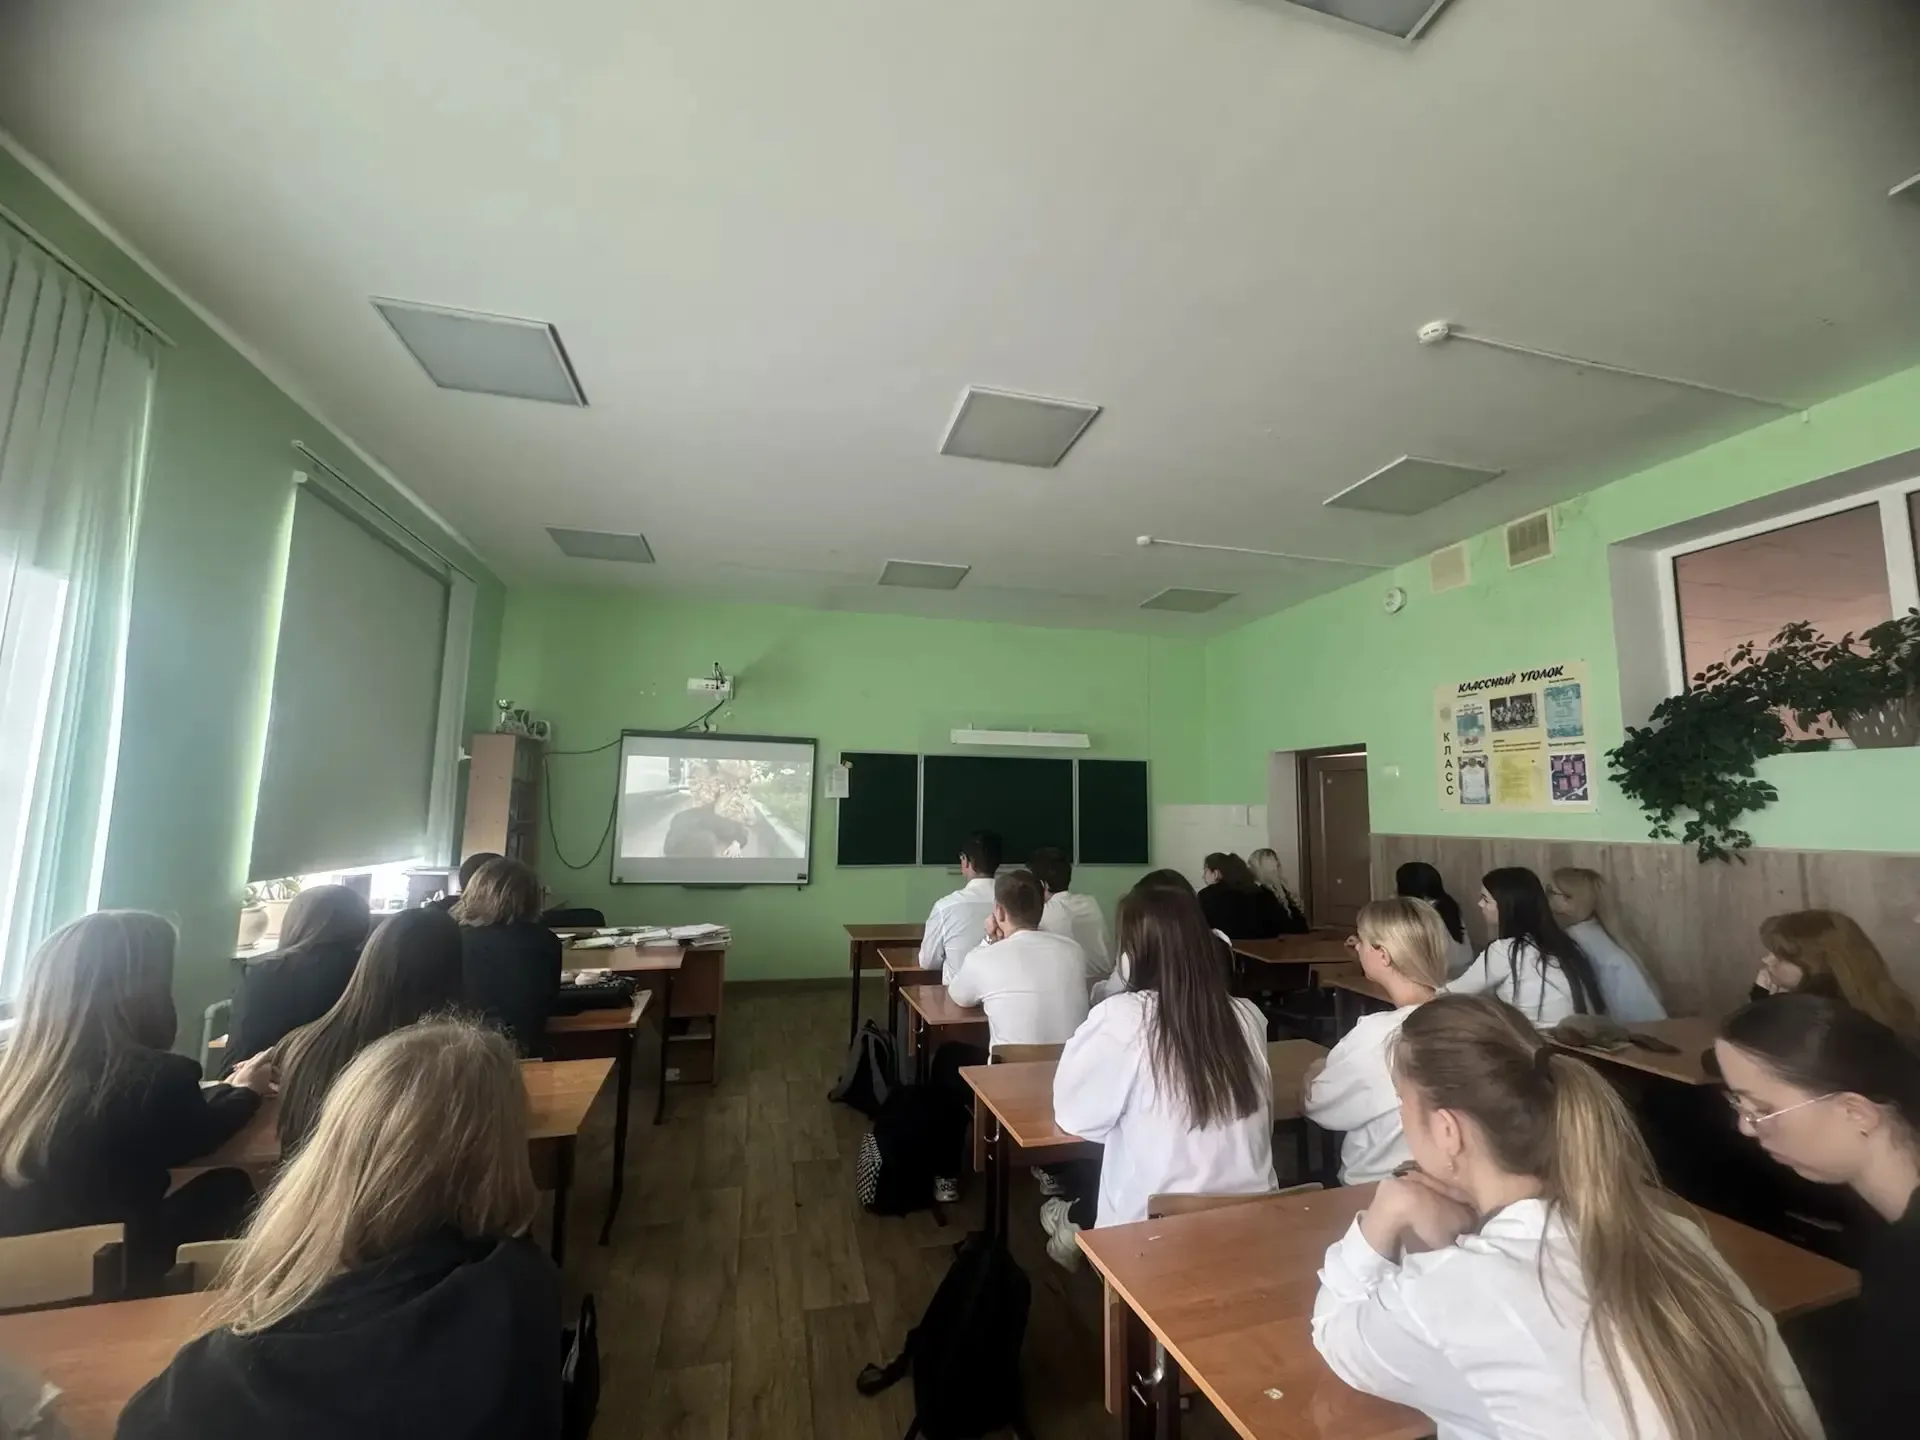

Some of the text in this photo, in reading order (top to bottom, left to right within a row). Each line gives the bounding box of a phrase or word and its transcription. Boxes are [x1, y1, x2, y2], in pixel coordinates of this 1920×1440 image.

[1458, 665, 1564, 693] КЛАССНЫЙ УГОЛОК
[1443, 732, 1454, 796] КЛАСС
